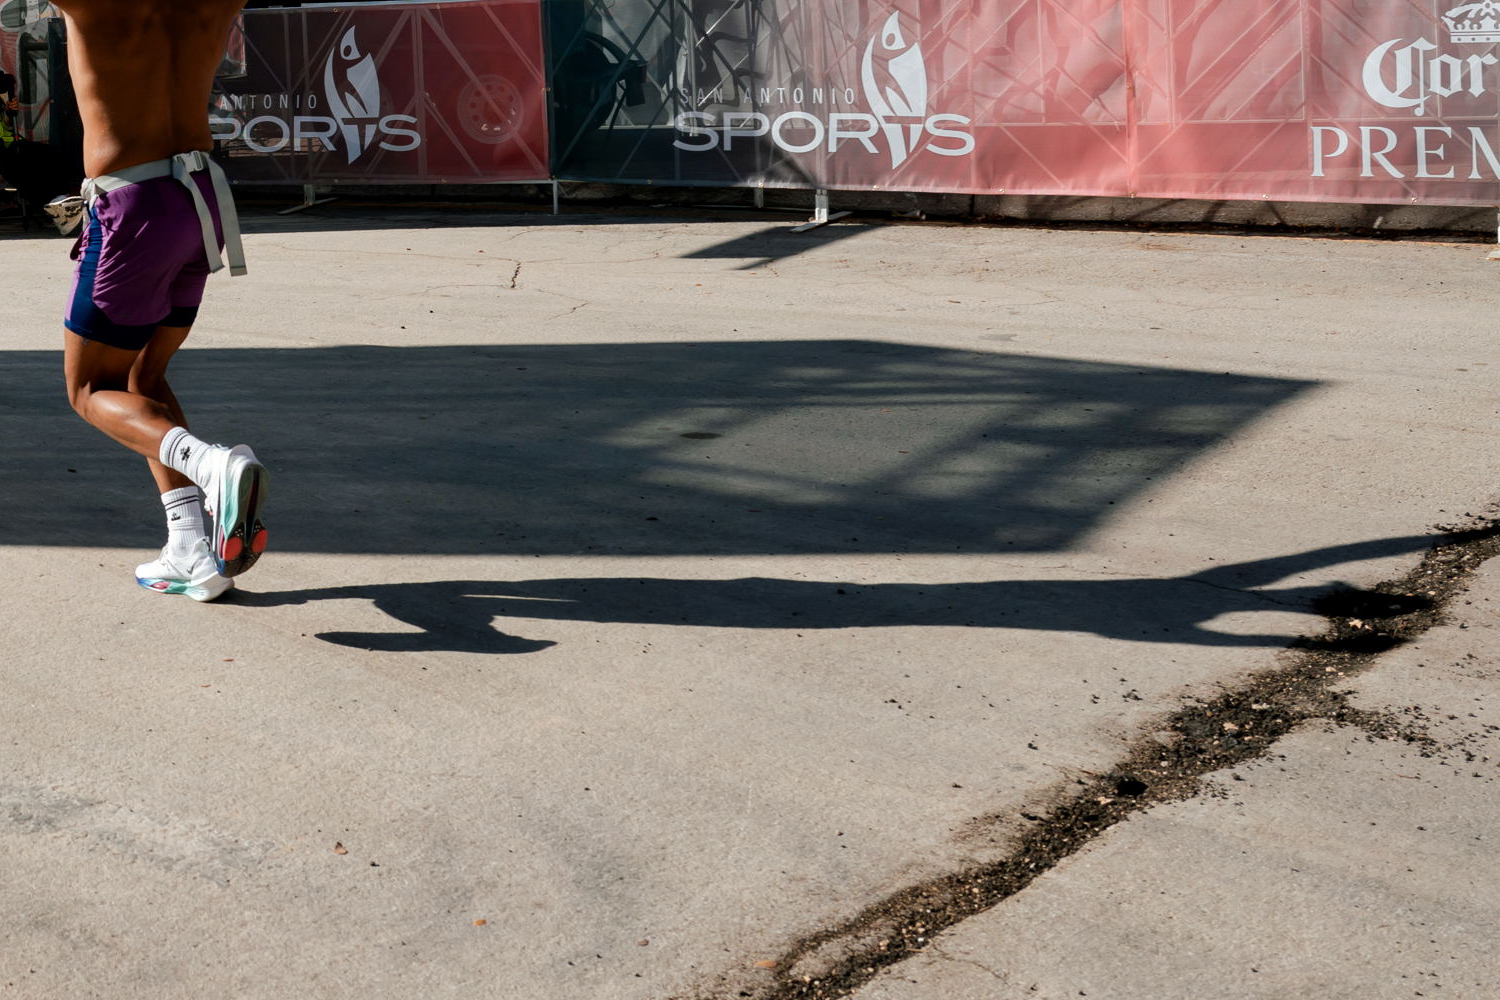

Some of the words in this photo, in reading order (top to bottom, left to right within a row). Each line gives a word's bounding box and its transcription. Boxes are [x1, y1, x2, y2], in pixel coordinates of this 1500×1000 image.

[221, 94, 318, 110] ANTONIO
[680, 87, 723, 104] SAN
[744, 87, 855, 105] ANTONIO
[672, 110, 976, 160] SPORTS
